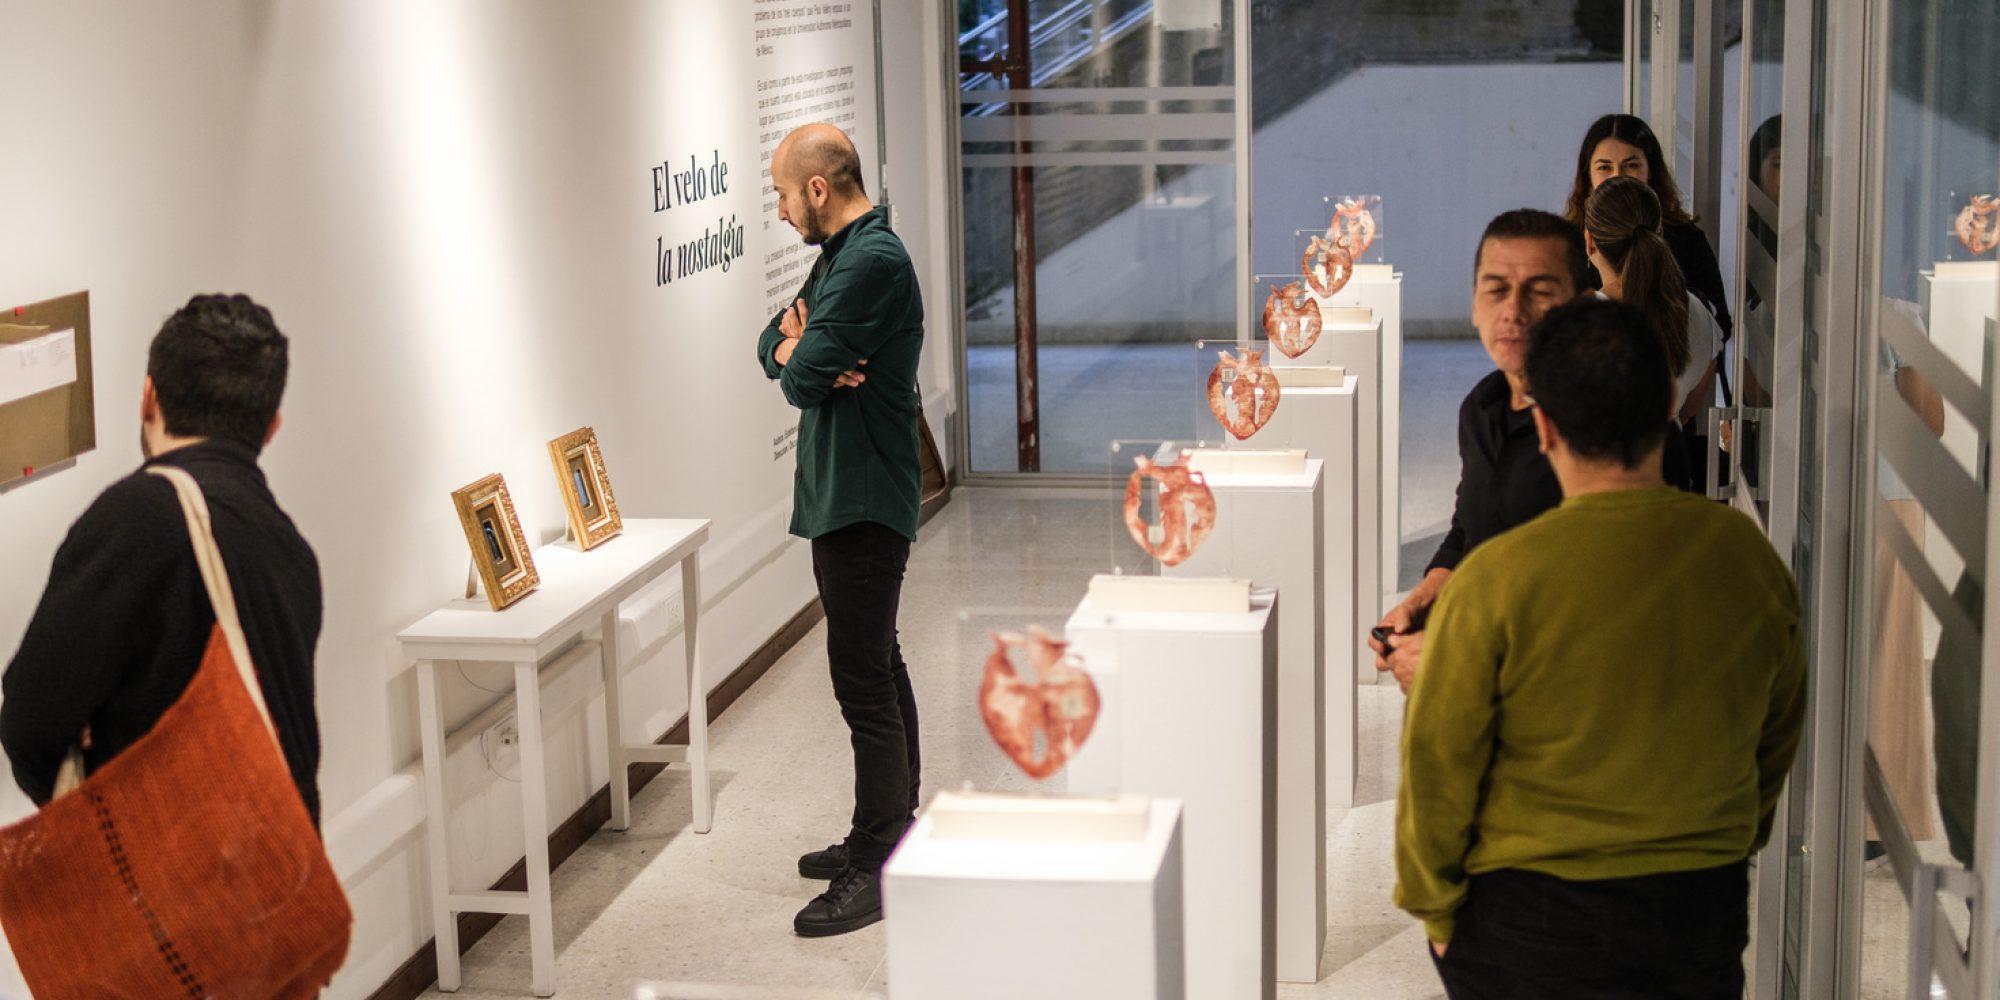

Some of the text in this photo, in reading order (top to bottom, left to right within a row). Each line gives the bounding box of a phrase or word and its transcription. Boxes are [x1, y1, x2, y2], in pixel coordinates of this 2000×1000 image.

[652, 149, 728, 213] El velo de
[657, 236, 672, 287] la
[677, 213, 744, 279] nostalgia
